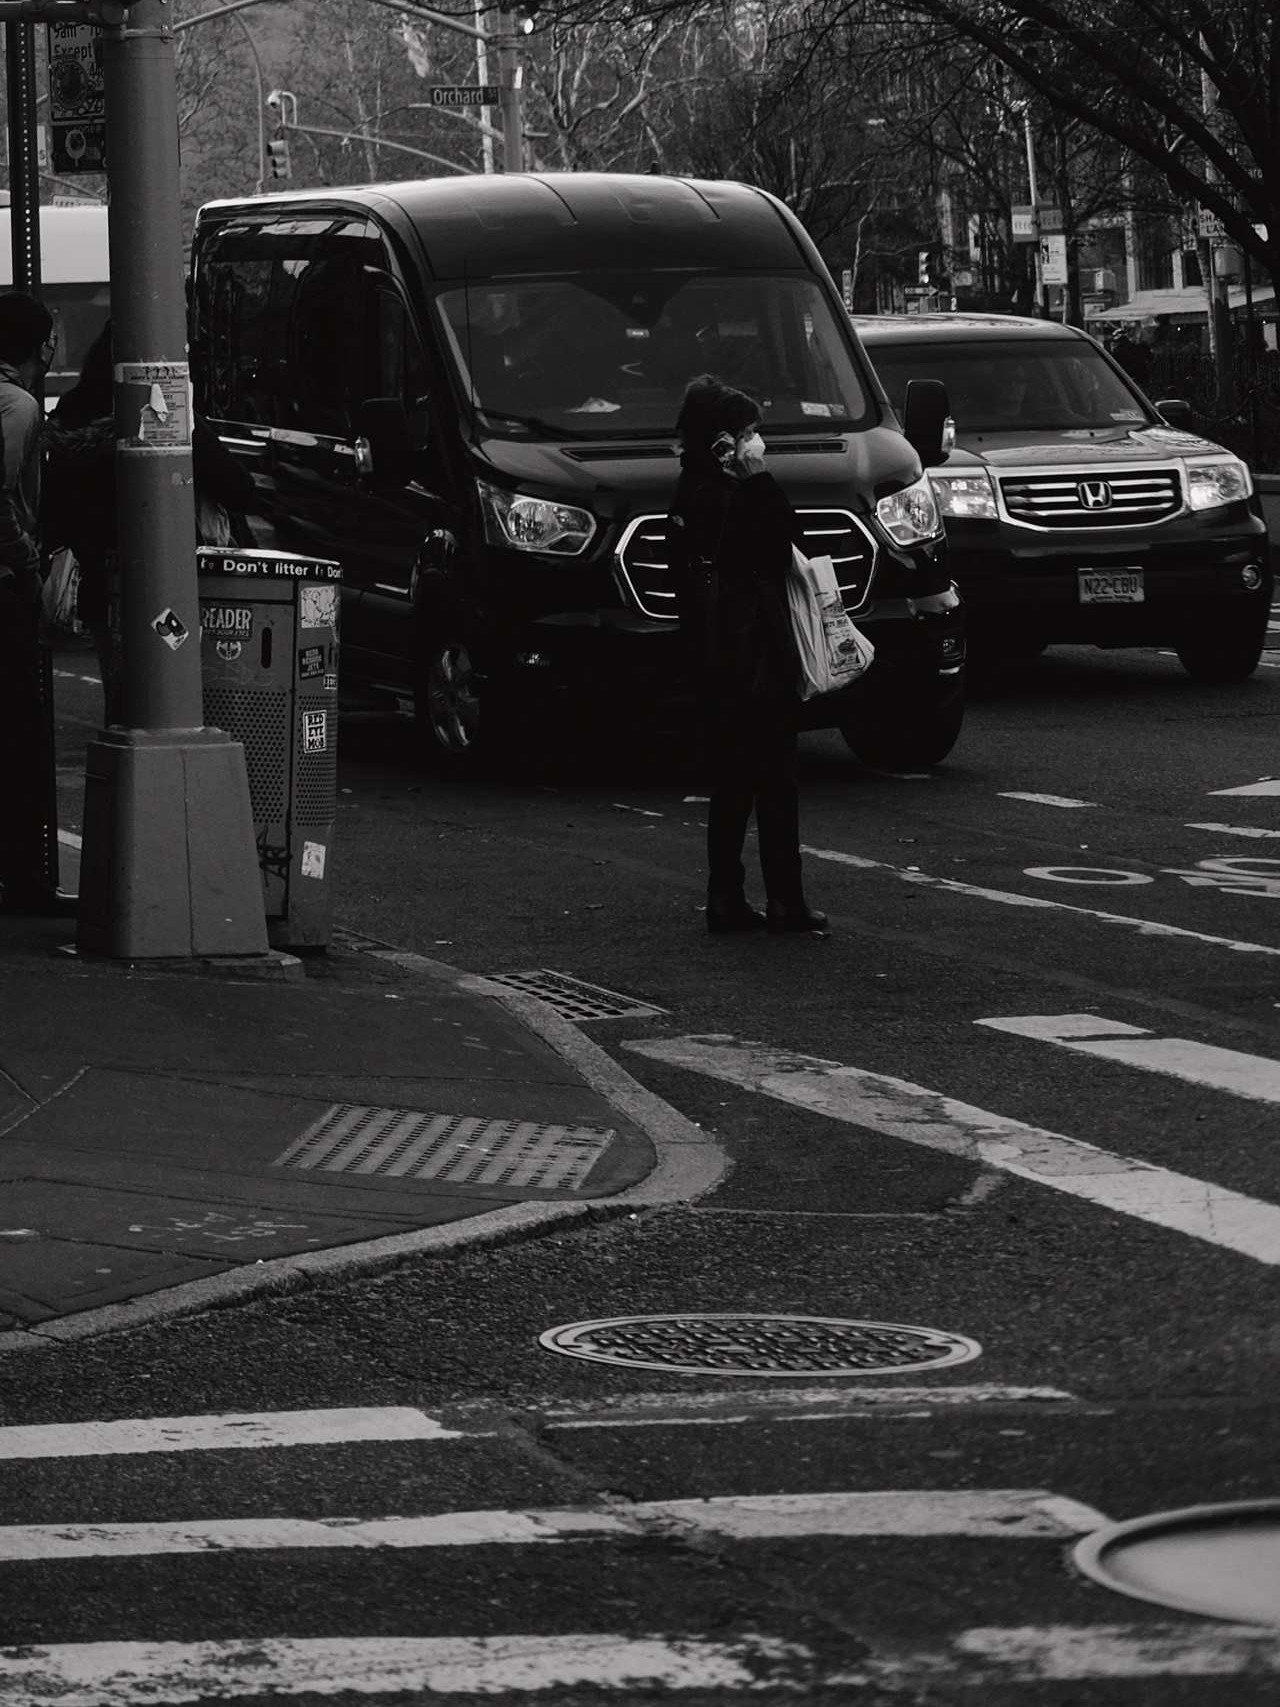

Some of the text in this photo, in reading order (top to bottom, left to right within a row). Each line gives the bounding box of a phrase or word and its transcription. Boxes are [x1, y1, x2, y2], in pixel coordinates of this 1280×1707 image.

[433, 87, 484, 105] Orchard
[223, 559, 309, 576] Don't litter
[307, 714, 324, 725] RED
[308, 726, 324, 737] EYE
[308, 737, 325, 749] MOB
